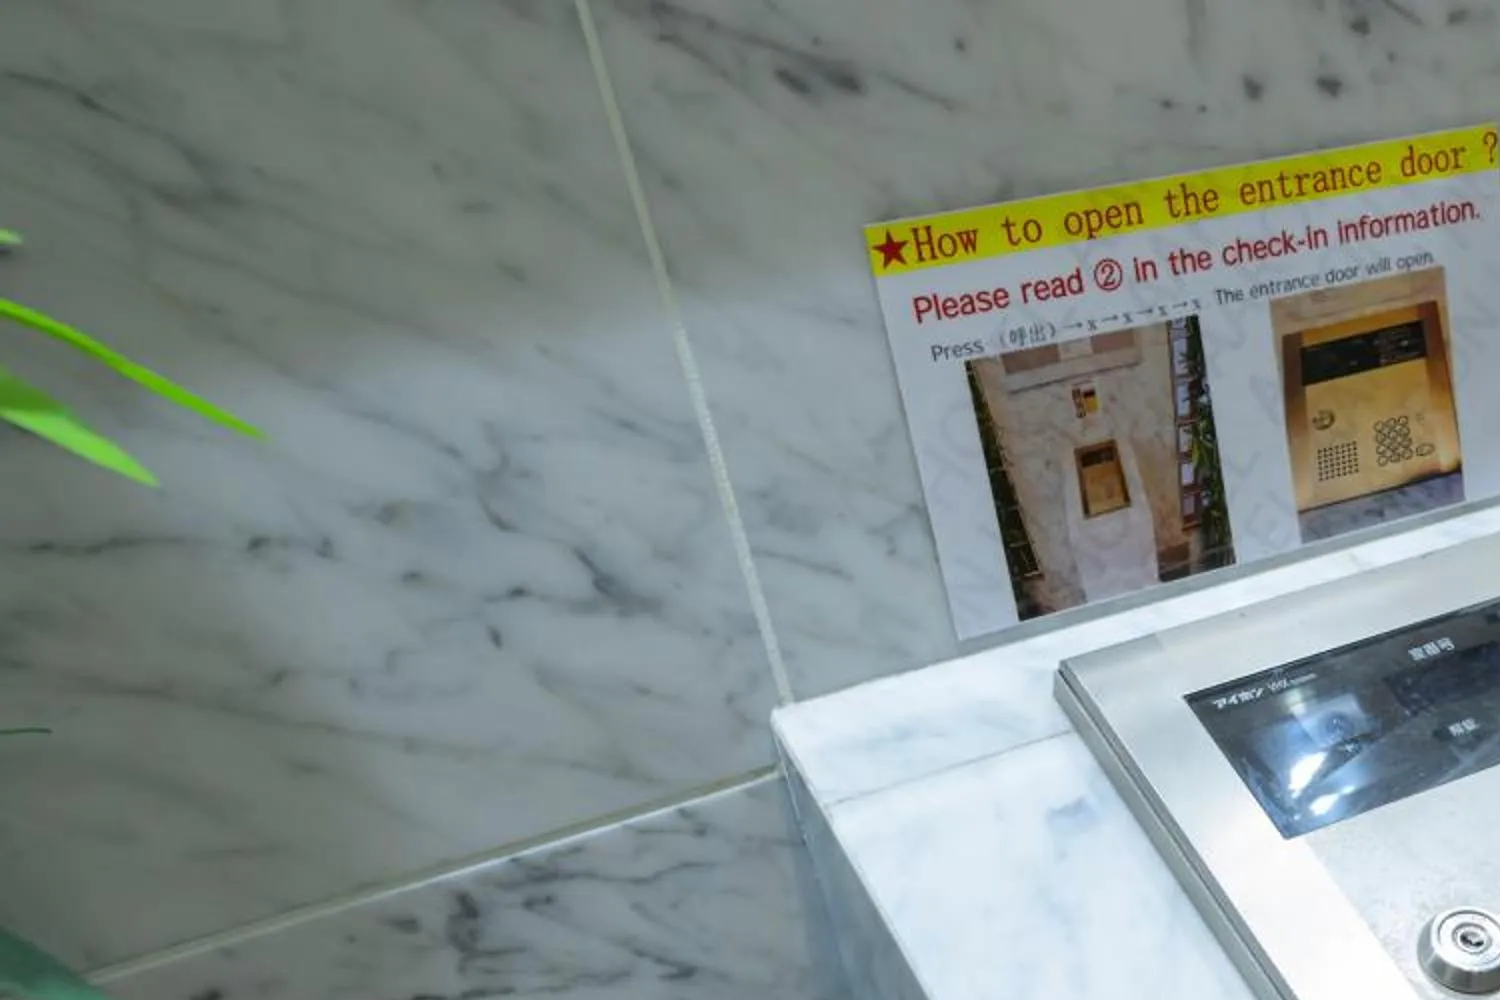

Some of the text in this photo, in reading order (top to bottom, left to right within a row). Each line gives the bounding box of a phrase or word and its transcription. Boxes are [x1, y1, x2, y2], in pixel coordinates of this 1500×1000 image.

[911, 131, 1498, 262] How to open the entrance door ?
[913, 287, 1010, 324] Please
[1021, 268, 1085, 304] read
[1133, 257, 1158, 283] in
[1169, 247, 1213, 276] the
[1222, 225, 1328, 266] check-in
[1338, 200, 1481, 245] information.
[1215, 288, 1244, 305] The
[1249, 273, 1320, 299] entrance
[1325, 265, 1359, 285] door
[1365, 256, 1391, 276] will
[931, 338, 985, 362] Press
